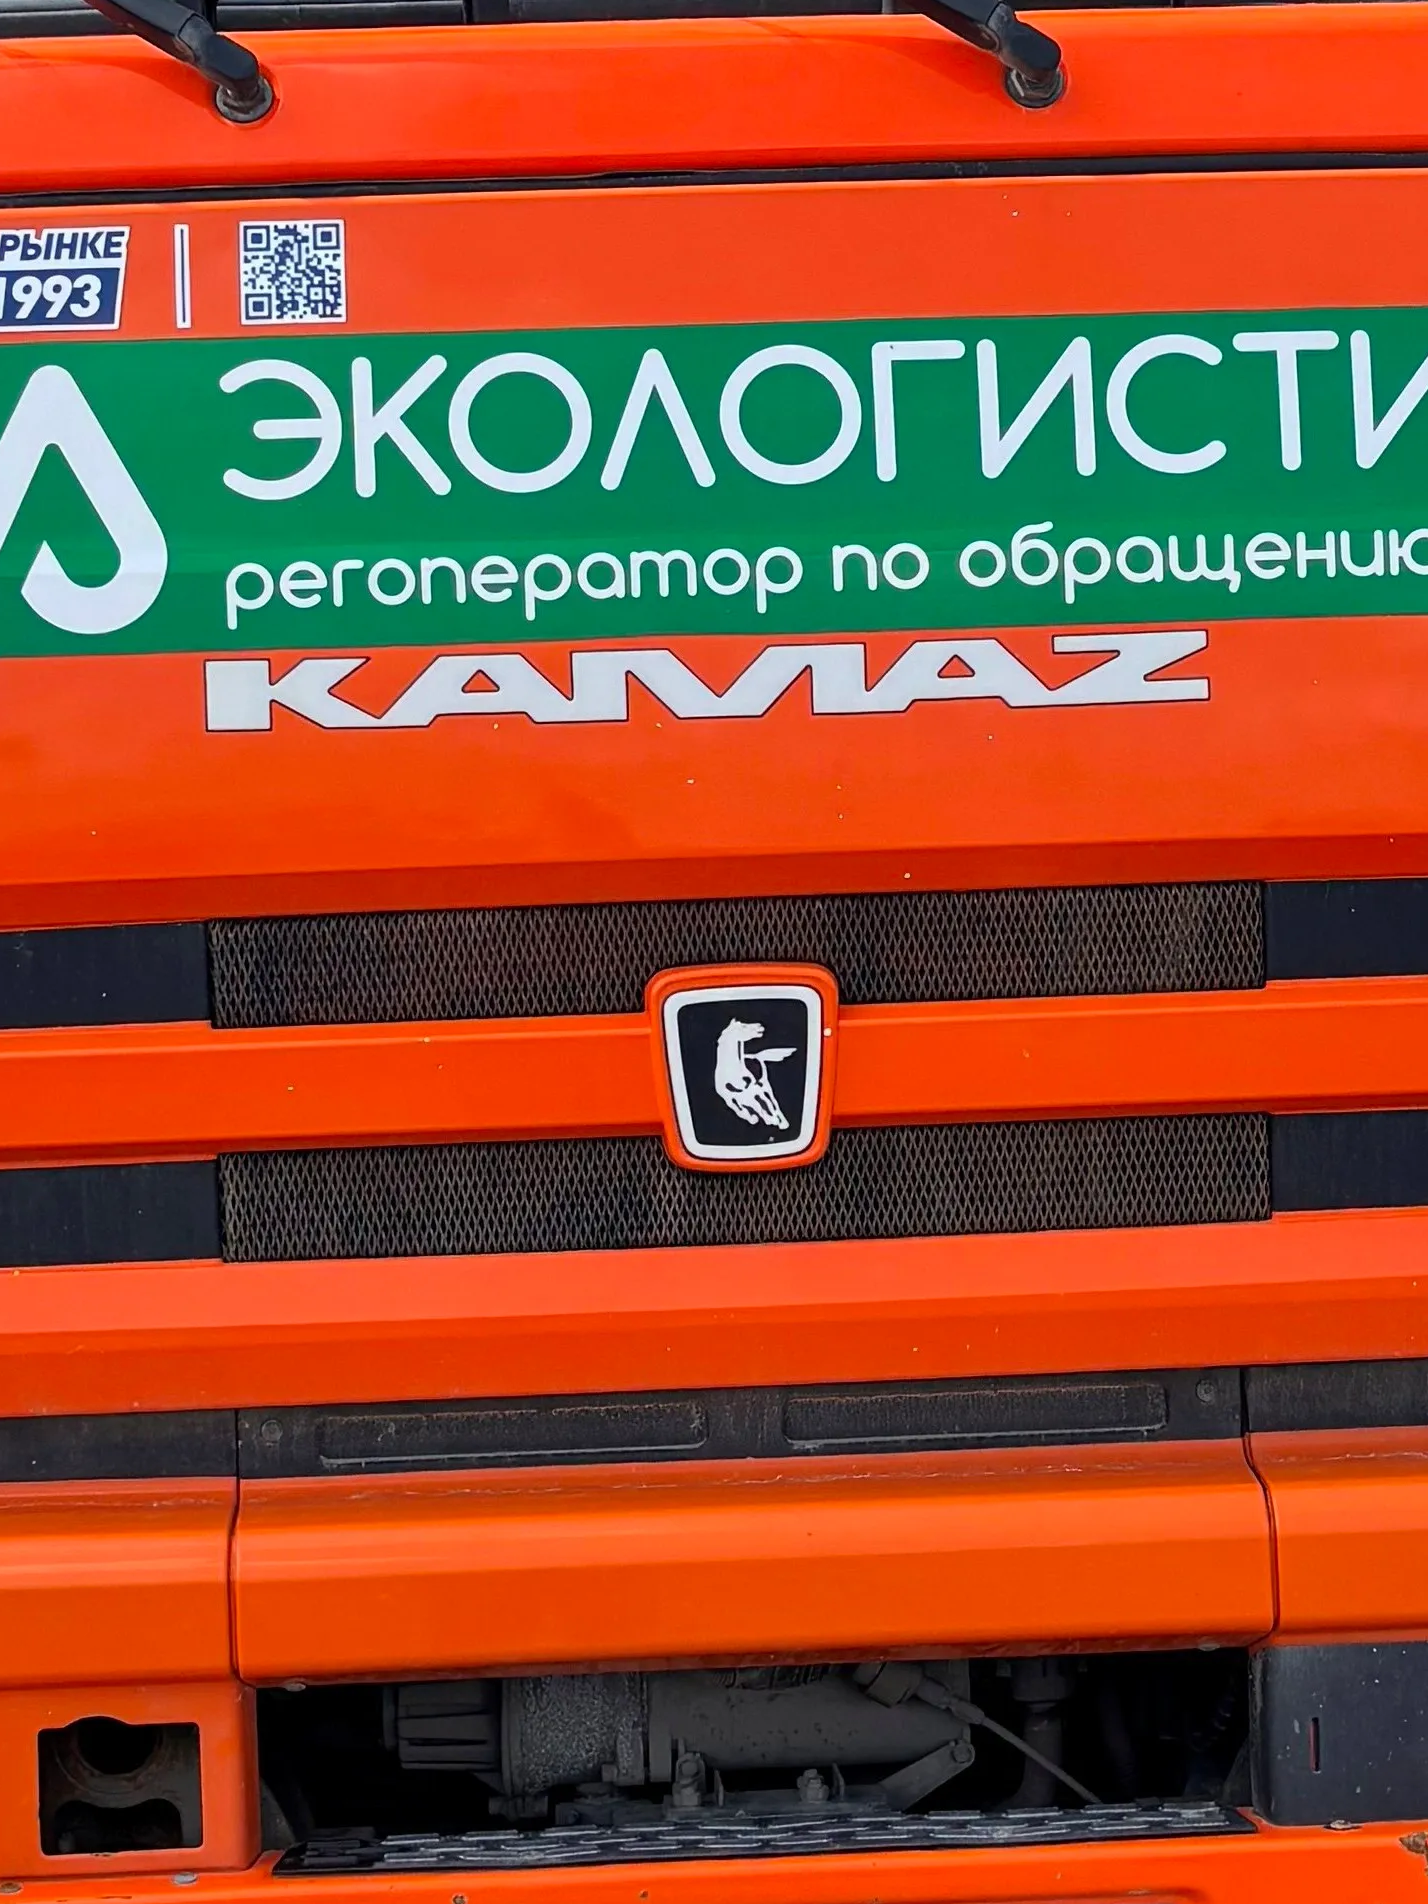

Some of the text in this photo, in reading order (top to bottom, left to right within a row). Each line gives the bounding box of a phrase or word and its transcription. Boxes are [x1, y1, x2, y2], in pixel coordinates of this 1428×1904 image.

[225, 546, 803, 630] регоператор
[832, 543, 930, 592] по
[204, 629, 1210, 732] KAMAZ
